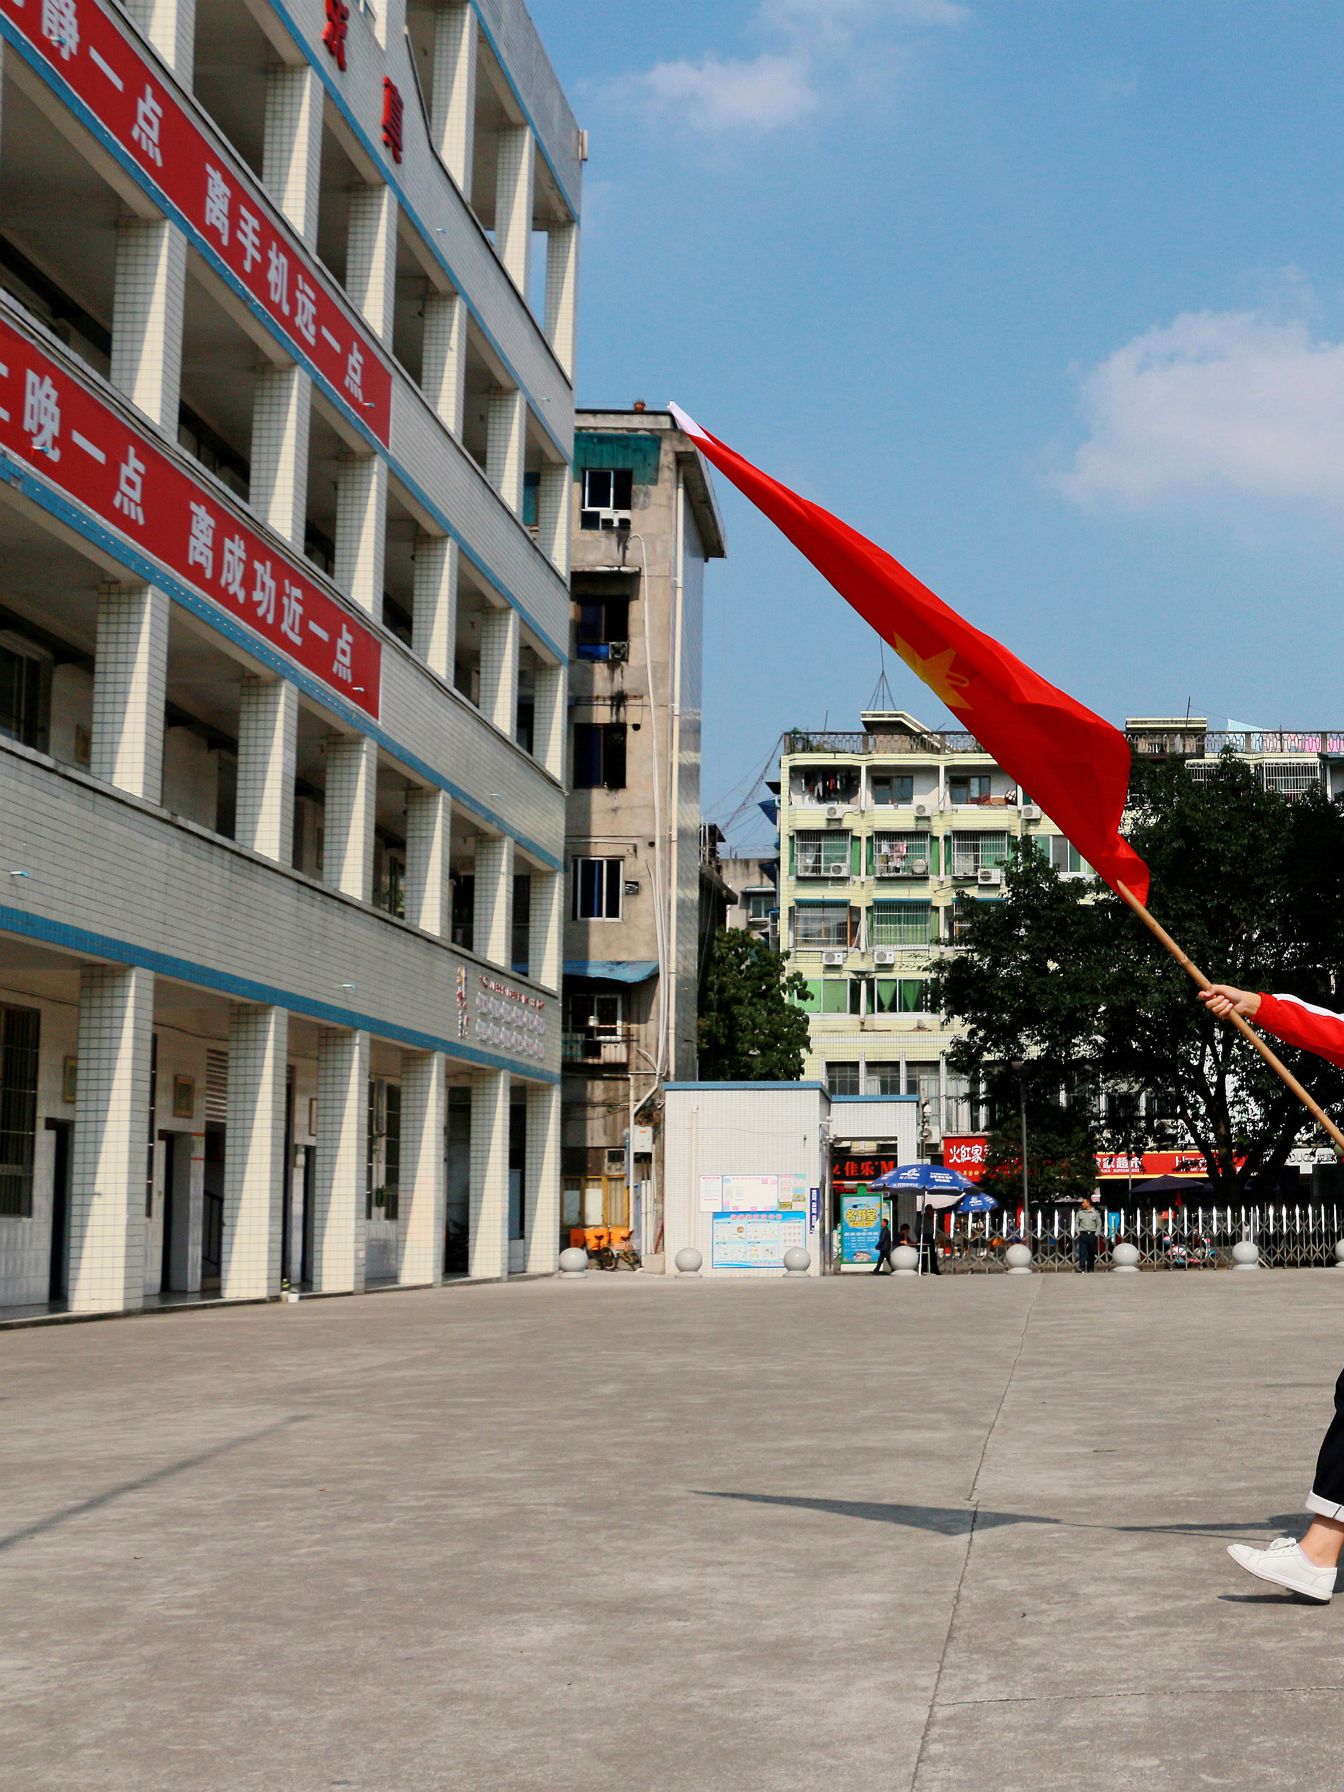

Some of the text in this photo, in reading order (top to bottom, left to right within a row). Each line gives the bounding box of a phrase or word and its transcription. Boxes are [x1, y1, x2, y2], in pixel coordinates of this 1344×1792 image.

[12, 0, 364, 403] 静一点 离手机远一点
[0, 362, 354, 683] 晚一点 离成功近一点
[948, 1144, 989, 1164] 火紅家
